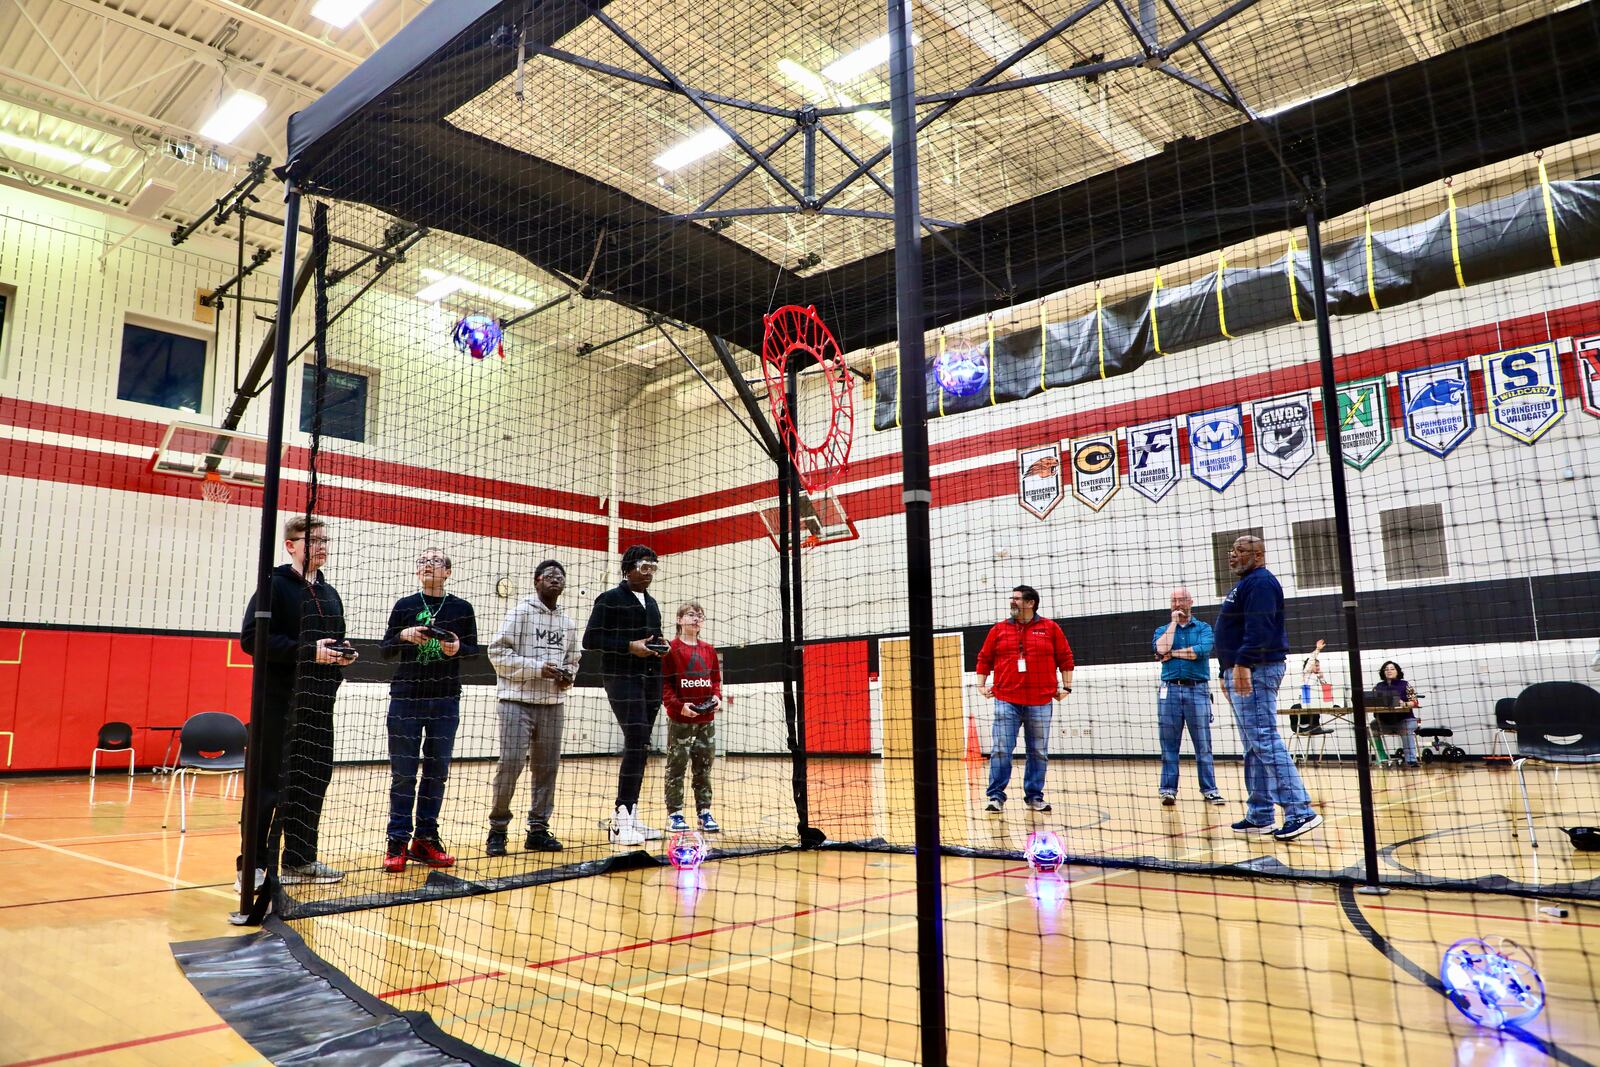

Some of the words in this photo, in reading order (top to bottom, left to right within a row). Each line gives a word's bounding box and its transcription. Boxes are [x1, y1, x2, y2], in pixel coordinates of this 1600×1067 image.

[1501, 352, 1538, 390] S
[1501, 387, 1548, 401] WILDCATS
[1501, 402, 1551, 416] SPRINGFIELD
[1415, 416, 1462, 429] SPRINGBORO
[1506, 411, 1548, 423] WILDCATS
[1421, 424, 1458, 436] PANTHERS
[1196, 424, 1235, 449] M
[1199, 455, 1237, 467] MIAMISBURG
[1140, 467, 1169, 477] FAIRMONT
[1207, 463, 1231, 472] VIKINGS
[1080, 477, 1111, 487] CENTERVILLE
[1140, 474, 1170, 483] FIREBIRDS
